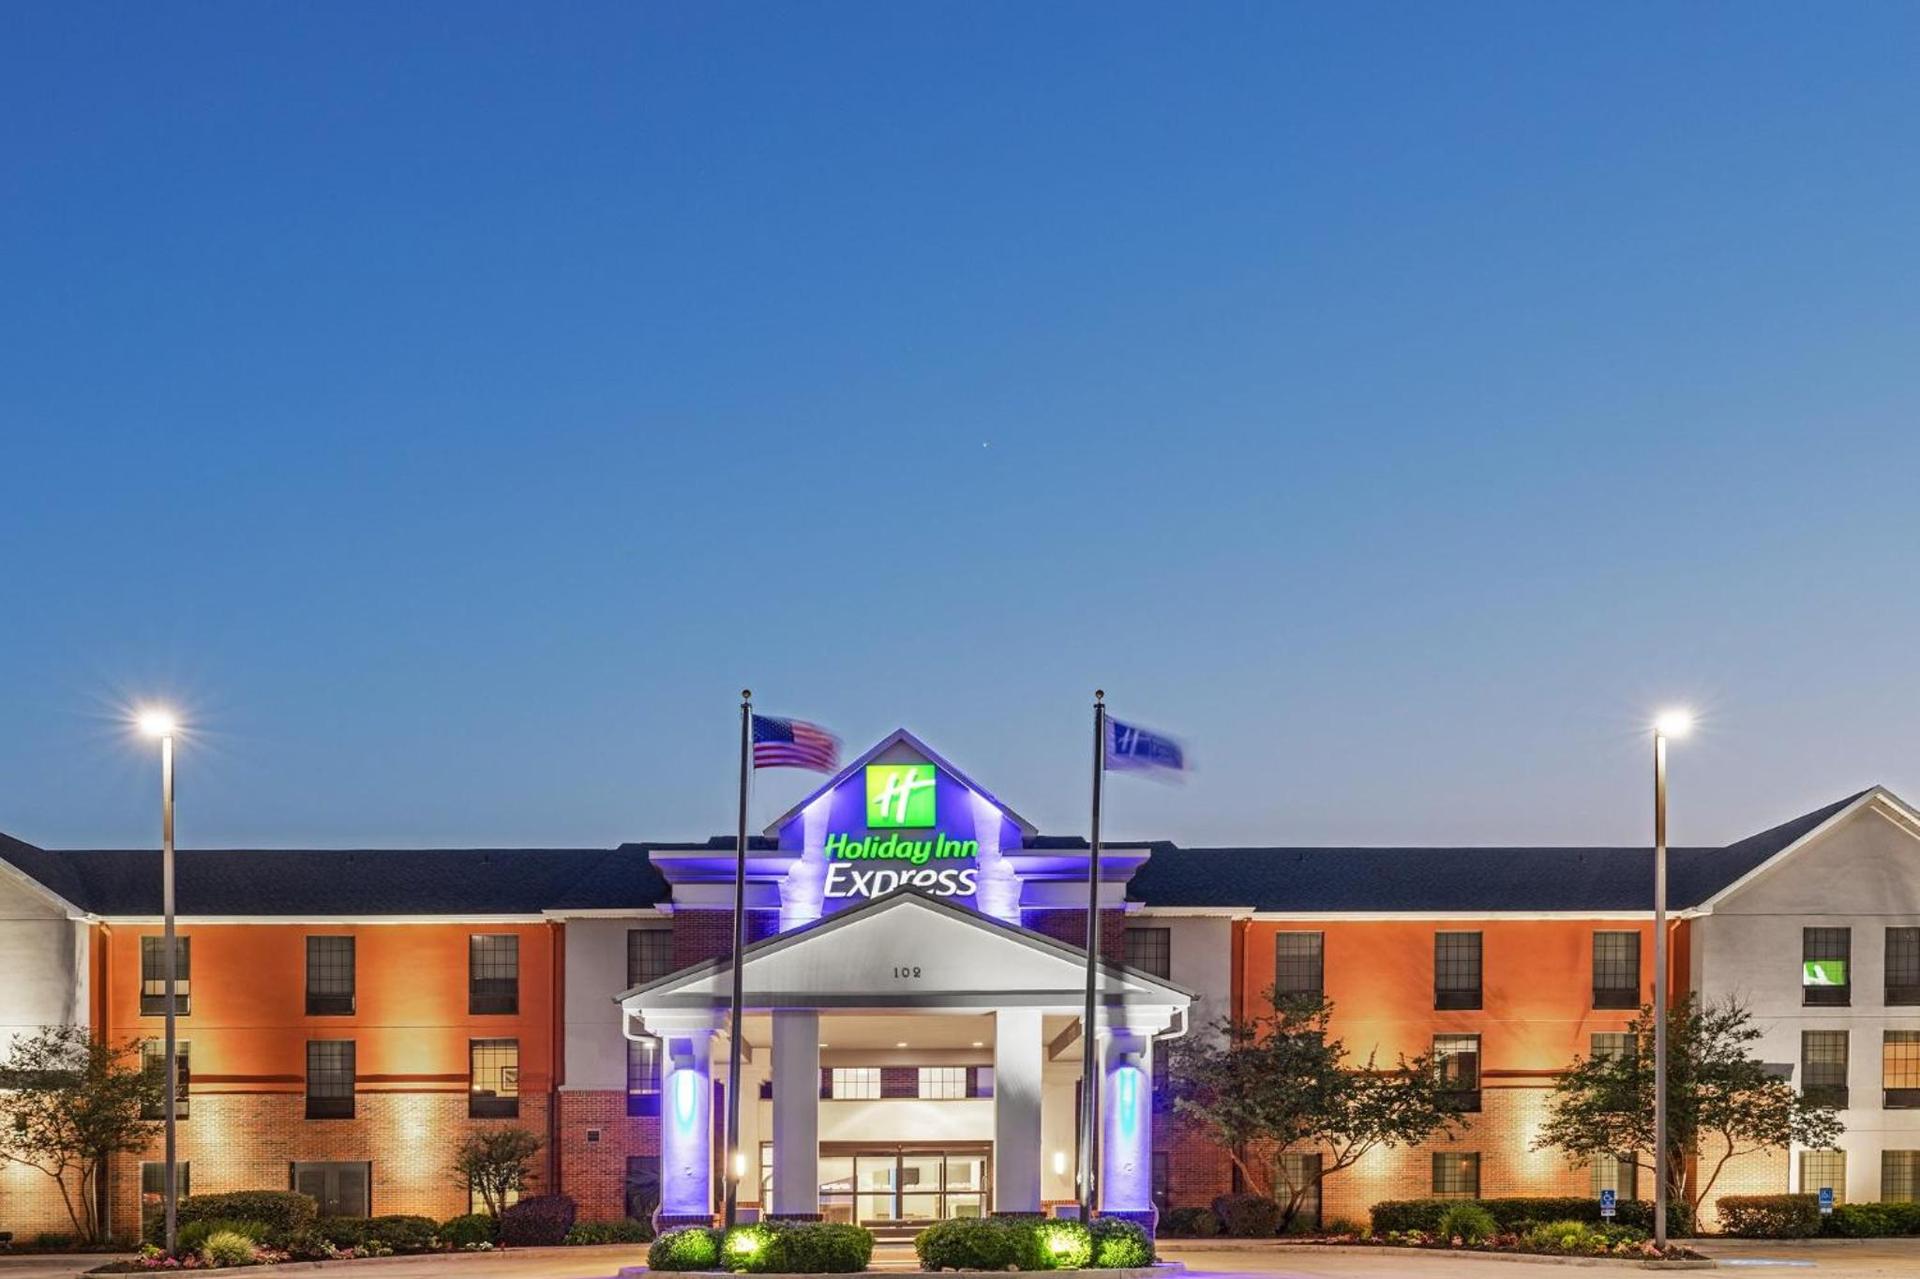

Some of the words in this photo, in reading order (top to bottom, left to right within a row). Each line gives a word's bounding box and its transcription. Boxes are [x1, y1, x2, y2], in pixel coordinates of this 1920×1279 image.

[872, 768, 936, 823] H
[824, 832, 932, 864] Holiday
[936, 832, 979, 858] Inn
[894, 967, 921, 978] 102
